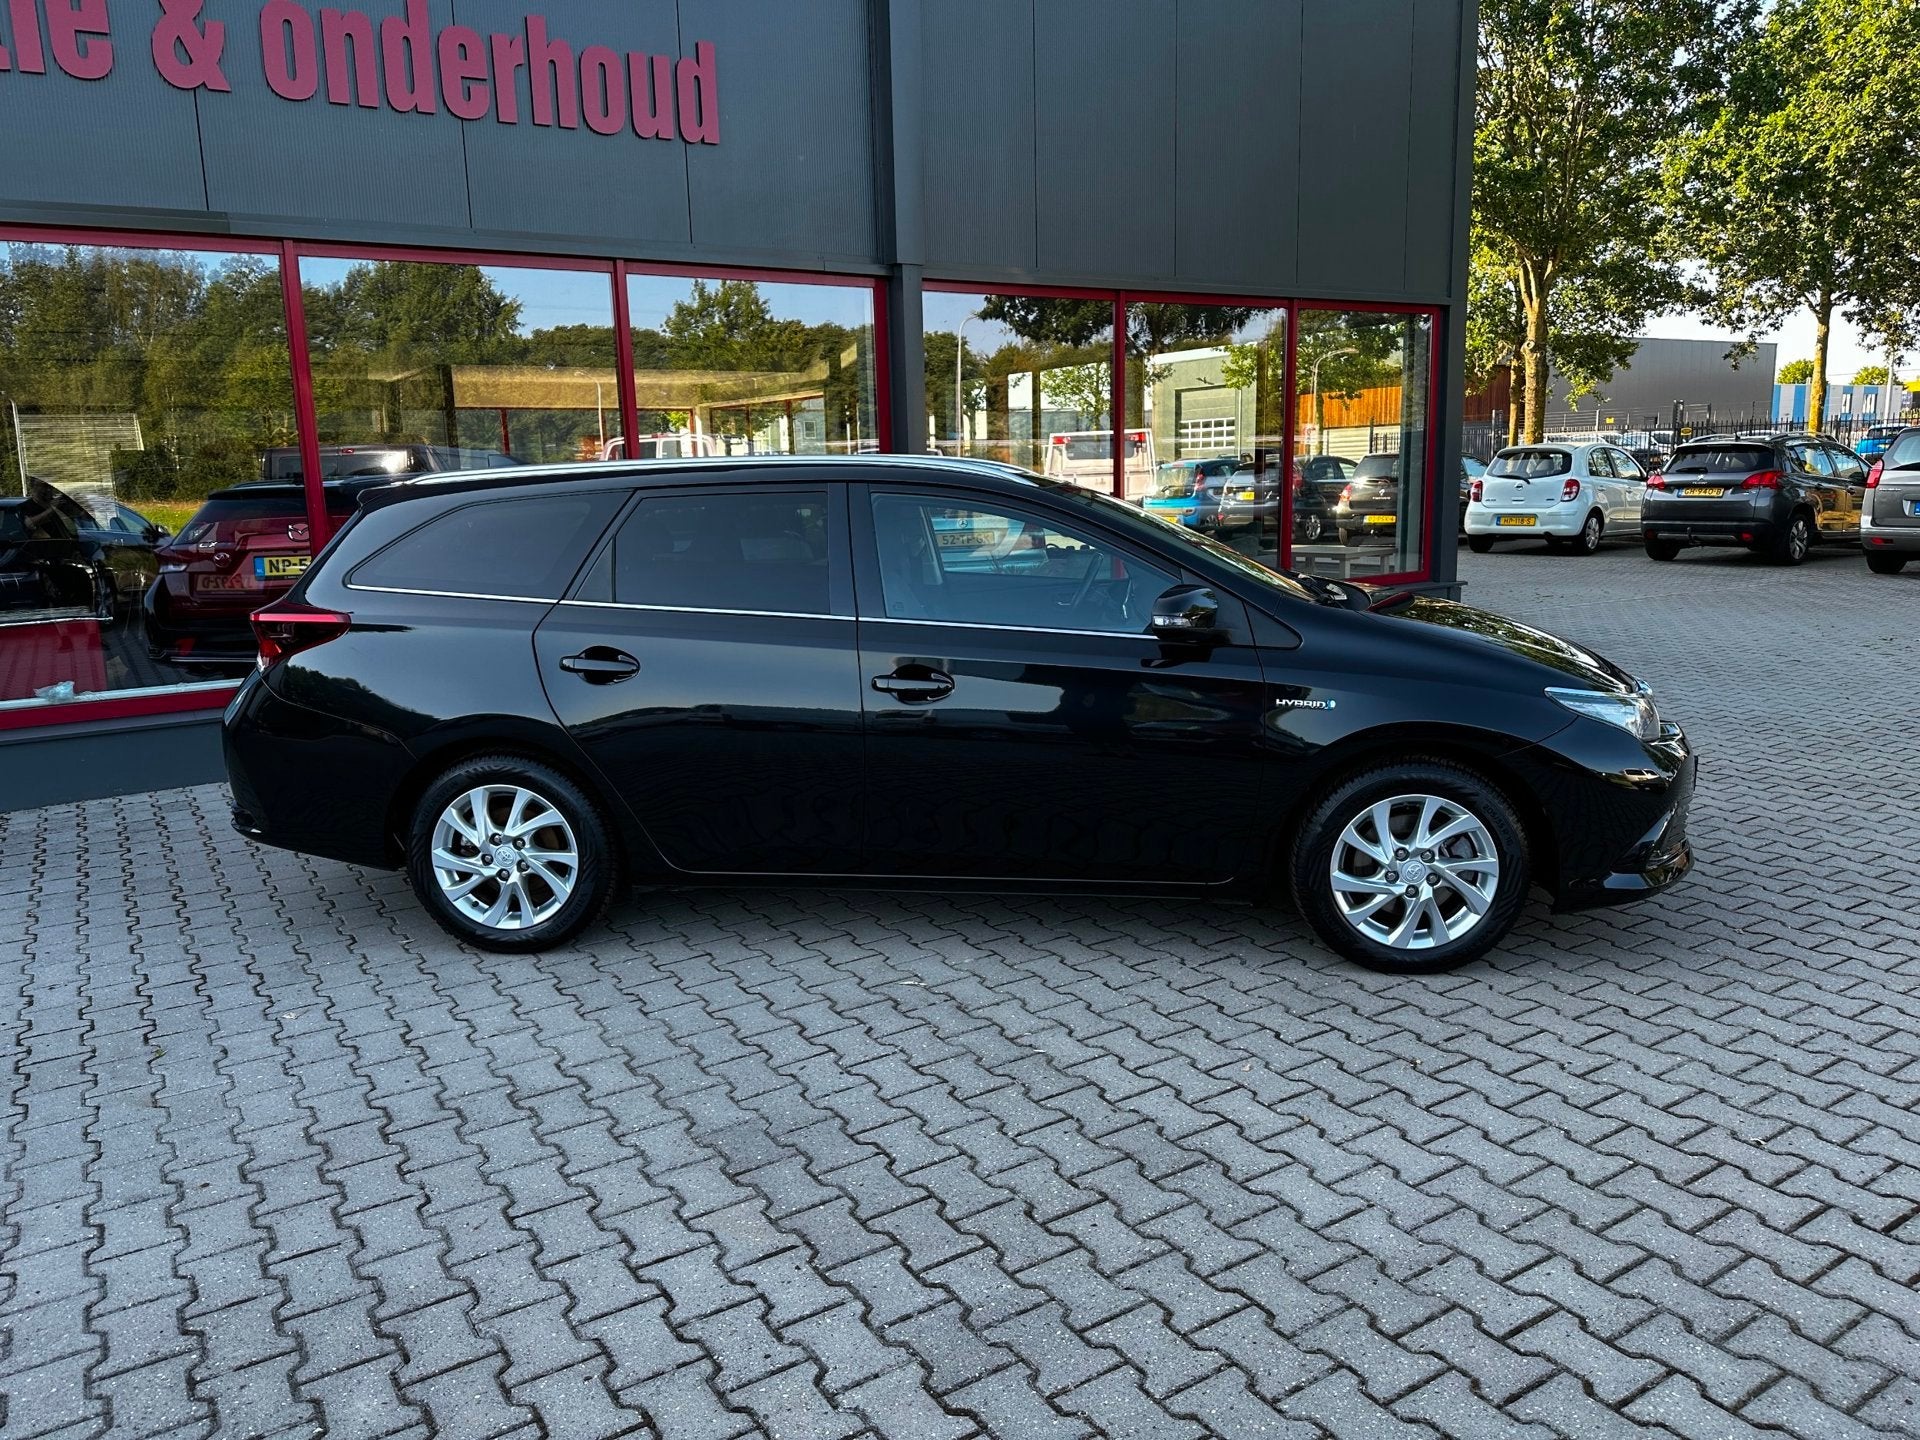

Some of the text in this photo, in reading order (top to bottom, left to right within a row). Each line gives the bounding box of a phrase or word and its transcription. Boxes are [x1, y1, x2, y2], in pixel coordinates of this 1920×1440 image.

[0, 0, 720, 145] ie & onderhoud
[1275, 698, 1327, 709] HYBRID
